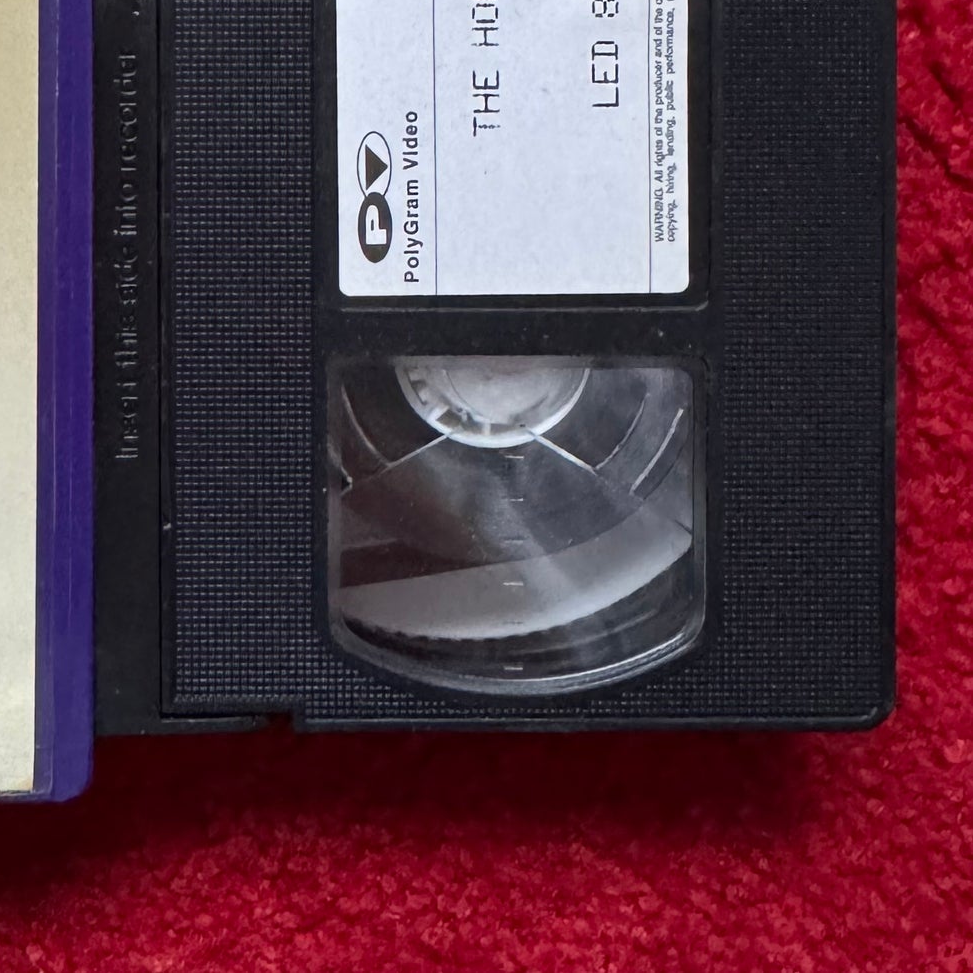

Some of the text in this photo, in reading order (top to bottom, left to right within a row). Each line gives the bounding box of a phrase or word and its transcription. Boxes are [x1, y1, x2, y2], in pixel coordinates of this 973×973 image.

[652, 25, 663, 34] of
[653, 7, 664, 23] the
[653, 37, 663, 57] and
[664, 6, 676, 73] performance,
[591, 39, 619, 107] LED
[653, 59, 665, 104] producer
[472, 69, 500, 136] THE
[664, 79, 676, 110] public
[653, 107, 664, 123] the
[654, 125, 663, 135] of
[654, 138, 666, 166] rights
[402, 109, 424, 282] PolyGram Video
[113, 51, 138, 459] Insert this side into recorder
